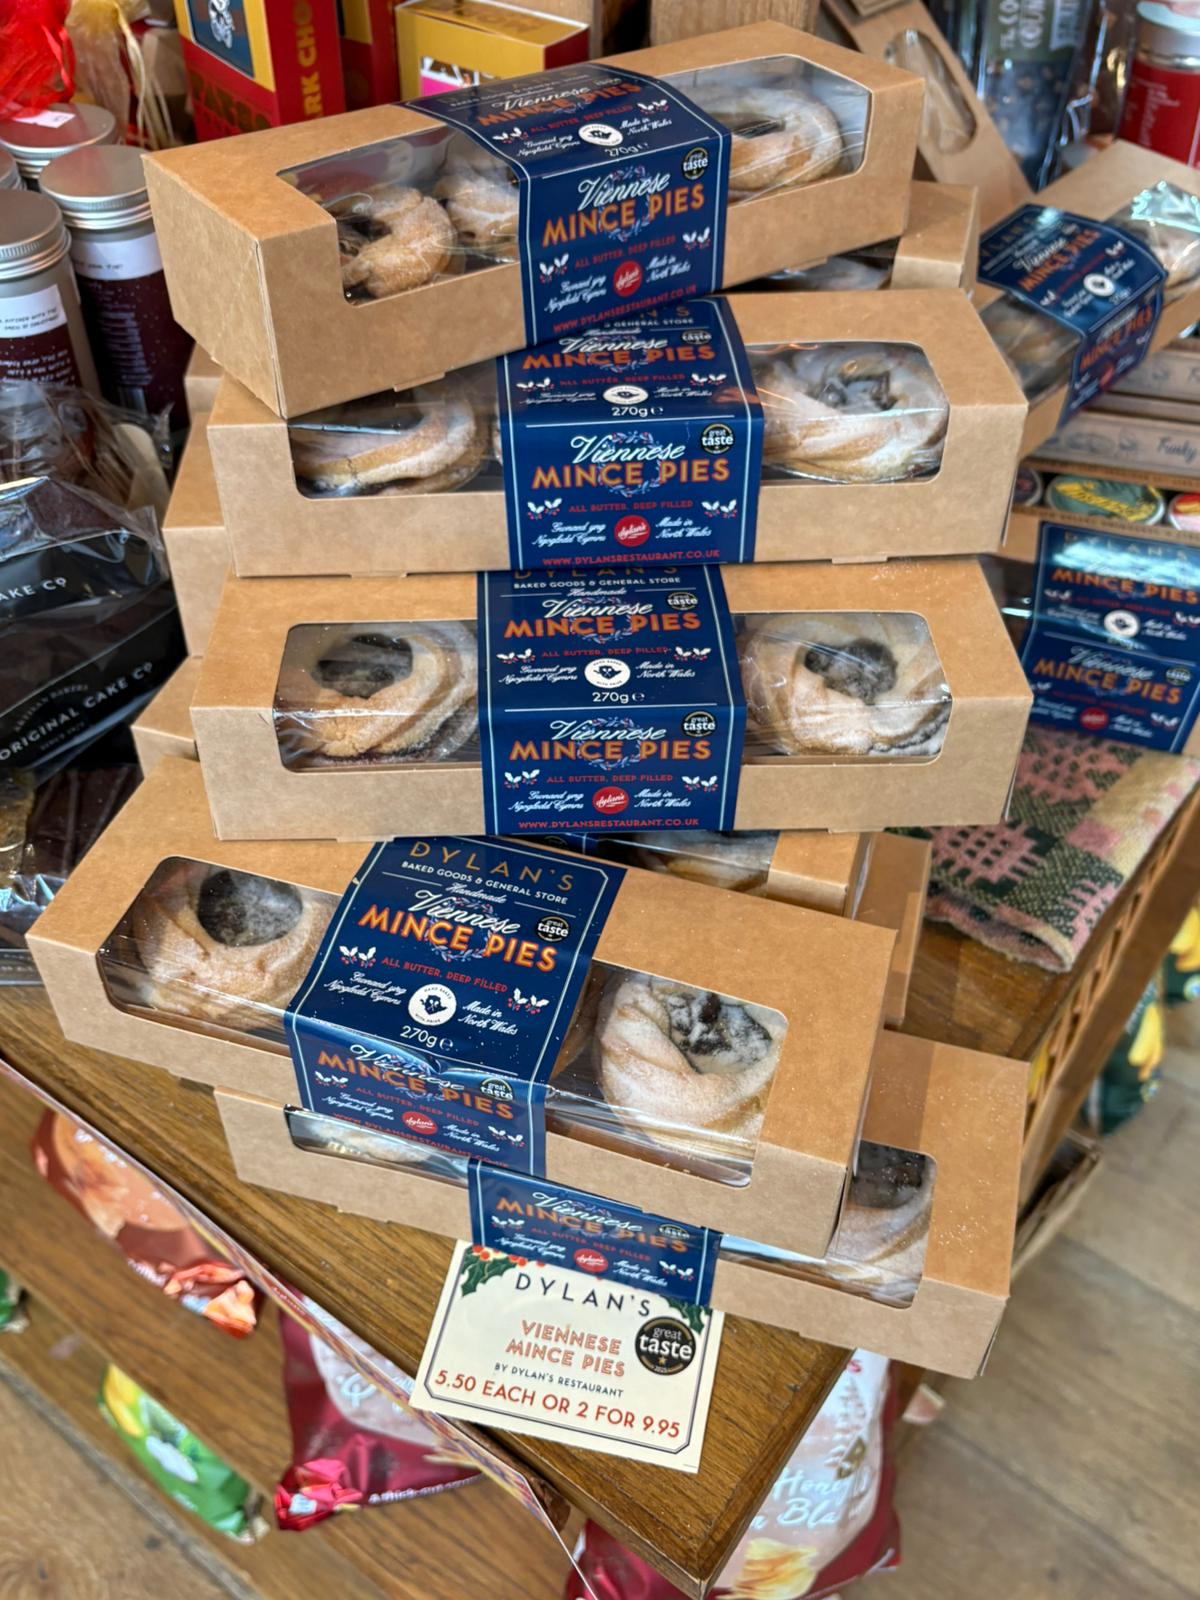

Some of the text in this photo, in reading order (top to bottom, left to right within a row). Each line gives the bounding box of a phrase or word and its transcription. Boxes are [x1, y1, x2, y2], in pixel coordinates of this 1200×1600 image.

[477, 96, 572, 126] MINCE
[585, 83, 641, 105] PIES
[491, 87, 590, 111] Viennese
[683, 157, 708, 172] taste
[577, 172, 671, 211] Viennese
[542, 183, 705, 248] MINCE PIES
[559, 335, 668, 354] Viennese
[522, 345, 716, 370] MINCE PIES
[611, 406, 648, 418] 270g
[570, 434, 686, 465] Viennese
[701, 434, 734, 447] taste
[531, 459, 731, 490] MINCE PIES
[569, 505, 587, 513] ALL
[542, 549, 720, 567] WWW.DYLANSRESTAURANT.CO.UK
[0, 584, 35, 601] AKE
[513, 576, 681, 590] BAKED GOODS GENERAL STORE
[1052, 567, 1134, 594] MINCE
[1143, 581, 1200, 606] PIES
[542, 598, 653, 619] Viennese
[667, 595, 698, 606] taste
[503, 611, 702, 639] MINCE PIES
[1032, 657, 1119, 690] MINCE
[1125, 678, 1182, 705] PIES
[592, 691, 630, 704] 270g
[0, 707, 80, 760] ORIGINAL
[83, 677, 129, 709] CAKE
[550, 720, 667, 742] Viennese
[683, 720, 717, 732] taste
[509, 740, 713, 761] MINCE PIES
[546, 775, 565, 783] ALL
[612, 774, 637, 783] DEEP
[640, 774, 673, 782] FILLED
[518, 818, 699, 830] WWW.DYLANSRESTAURANT.CO.UK
[409, 841, 574, 893] DYLAN'S
[401, 861, 434, 875] BAKED
[437, 867, 473, 883] GOODS
[485, 879, 533, 898] GENERAL
[535, 890, 568, 906] STORE
[445, 882, 508, 905] Handmade
[408, 889, 521, 935] Viennese
[358, 904, 559, 974] MINCE PIES
[536, 923, 569, 938] taste
[382, 957, 400, 968] ALL
[446, 970, 472, 984] DEEP
[474, 977, 508, 993] FILLED
[462, 1000, 492, 1015] Made
[458, 1013, 518, 1035] North Wales
[400, 1025, 437, 1049] 270g
[318, 1050, 513, 1121] MINCE PIES
[532, 1191, 643, 1233] Viennese
[496, 1197, 689, 1254] MINCE PIES
[515, 1273, 651, 1318] DYLAN'S
[521, 1319, 622, 1356] VIENNESE
[652, 1327, 682, 1341] great
[505, 1338, 627, 1378] MINCE PIES
[639, 1334, 692, 1360] taste
[494, 1362, 624, 1399] BY DYLAN'S RESTAURANT
[434, 1369, 682, 1440] 5.50 EACH OR 2 FOR 9.95
